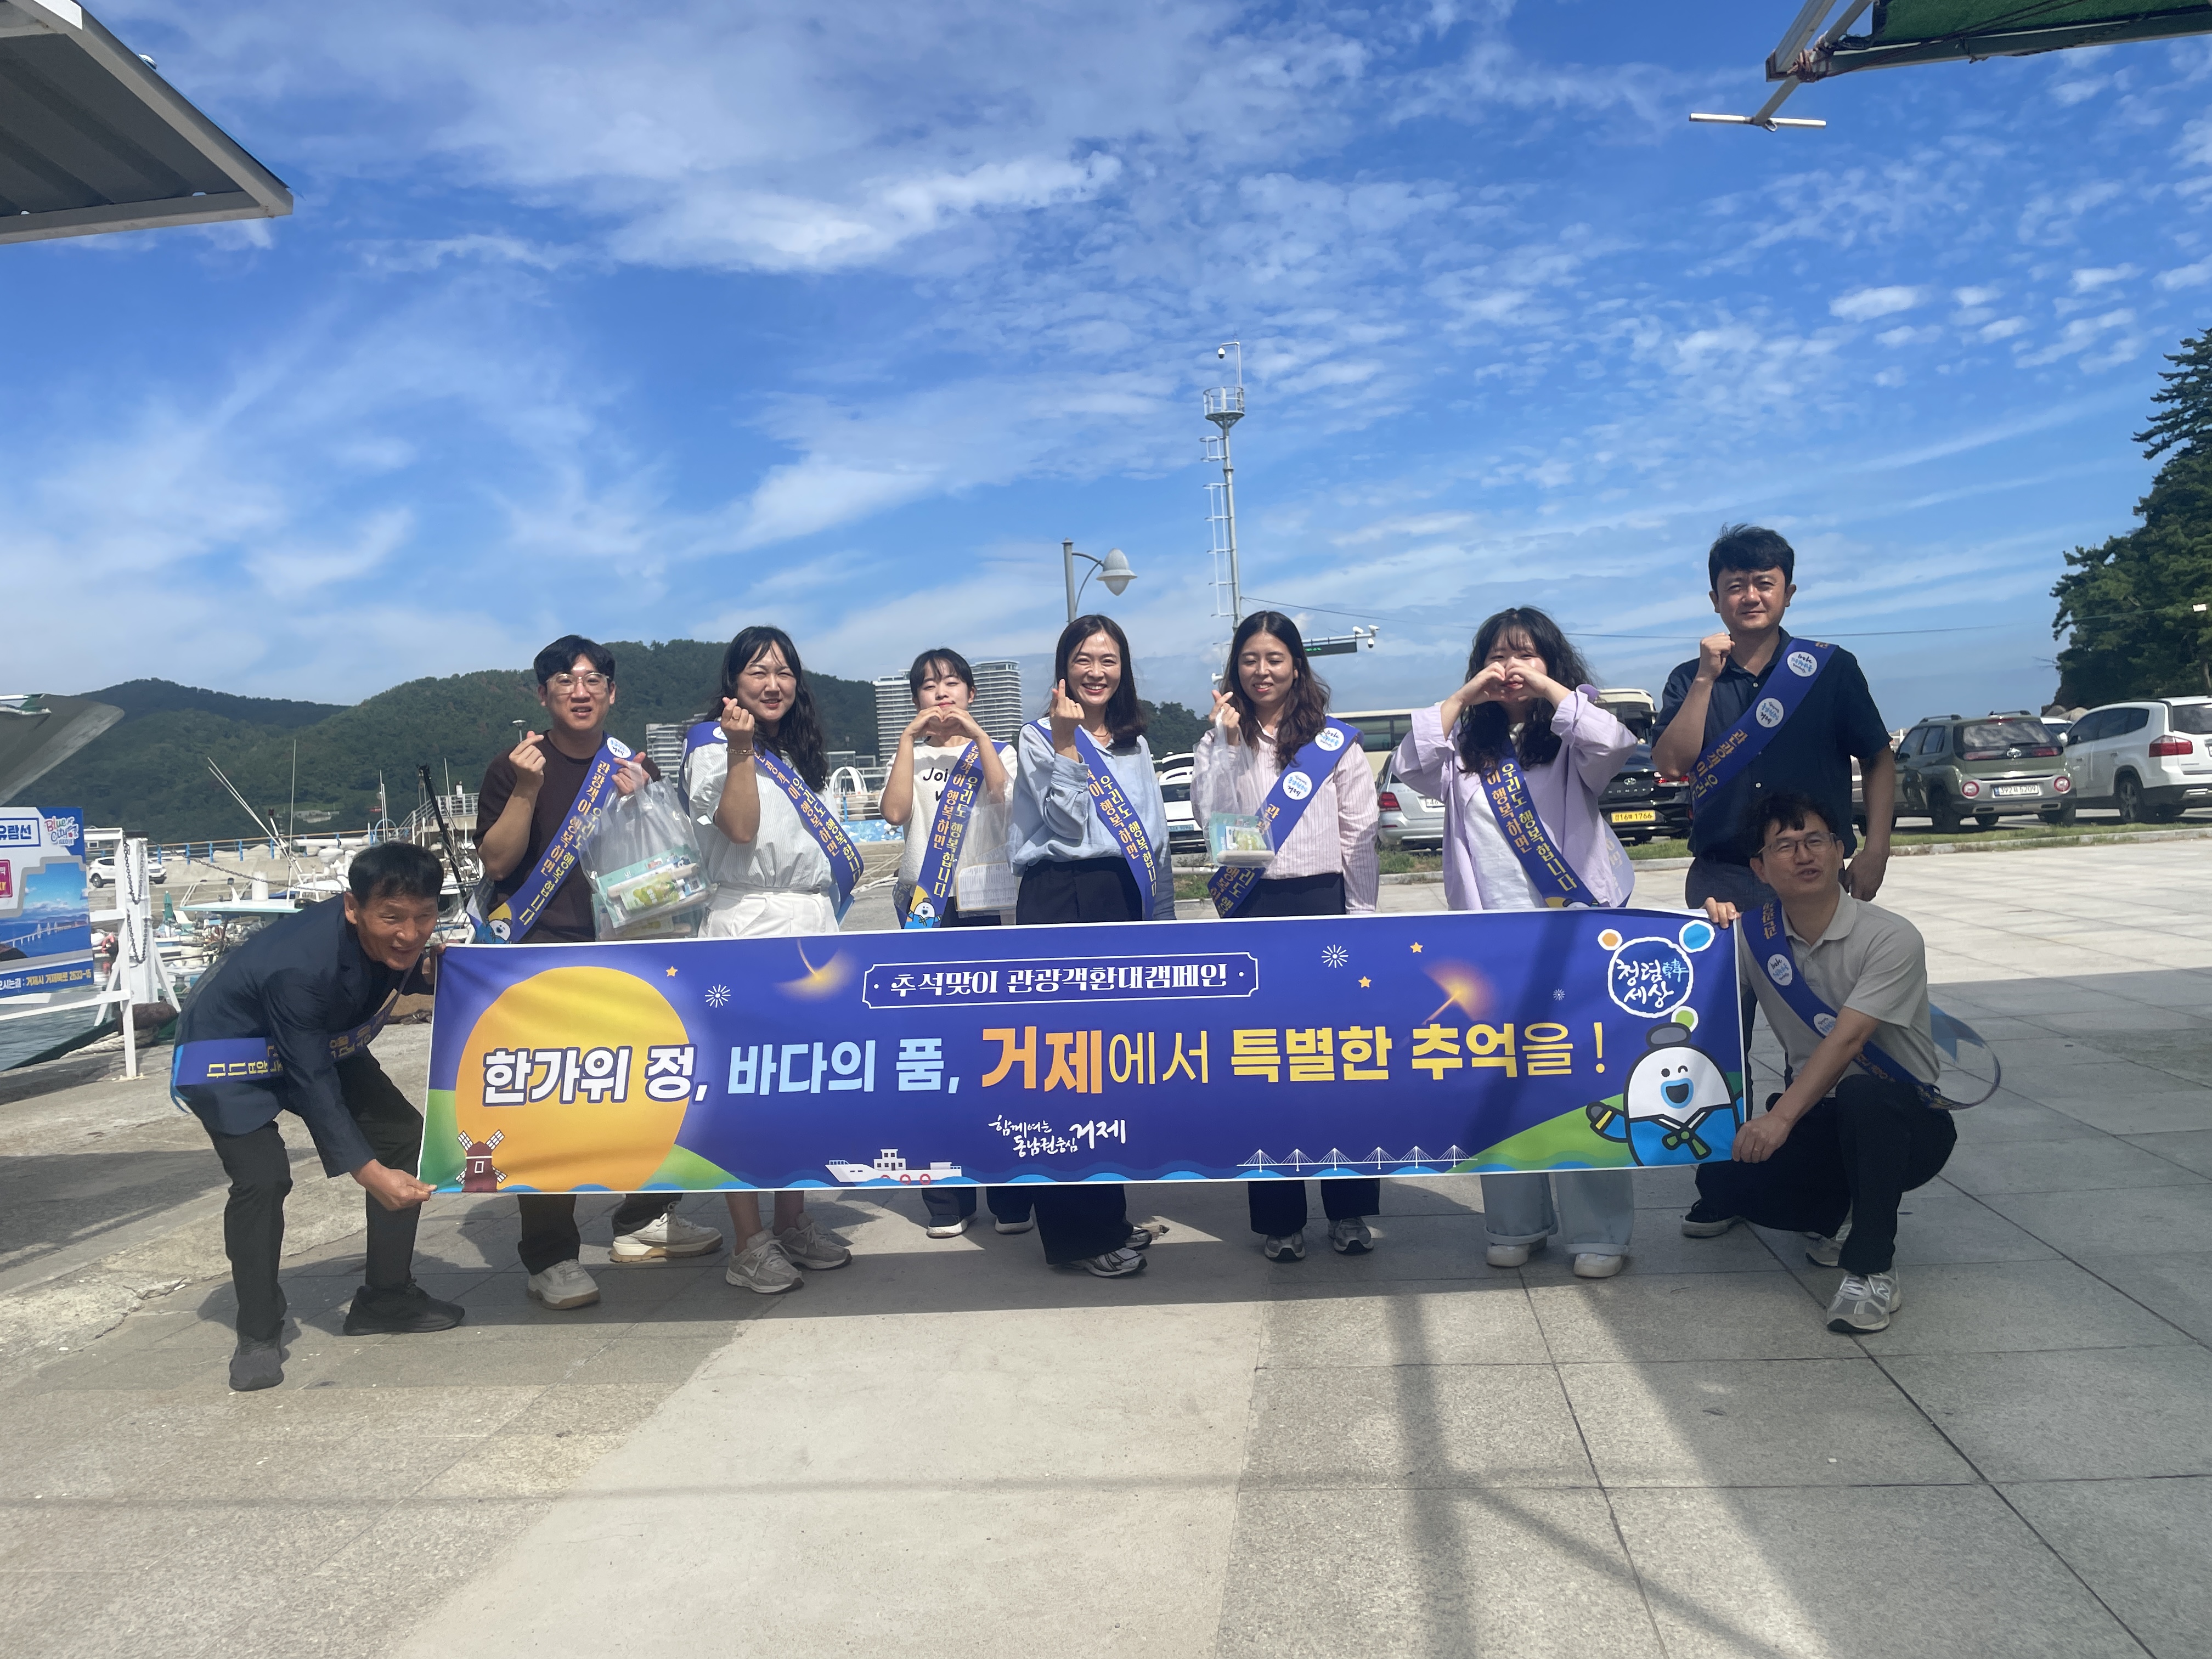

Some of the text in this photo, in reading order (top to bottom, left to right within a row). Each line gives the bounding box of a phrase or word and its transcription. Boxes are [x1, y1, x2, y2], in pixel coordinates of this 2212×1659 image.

[1696, 729, 1748, 777] 관광객이
[541, 760, 611, 877] 관광객이 행복하면
[792, 777, 826, 818] 우리도
[933, 789, 960, 850] 행복하면
[1100, 775, 1133, 820] 우리도
[1492, 787, 1532, 854] 행복하면
[44, 817, 66, 832] Blue
[800, 800, 840, 857] 행복하면
[933, 776, 978, 898] 우리도 행복합니다
[1099, 799, 1140, 860] 행복하면
[1502, 763, 1577, 891] 우리도 행복합니다
[518, 851, 575, 926] 행복합니다
[1211, 867, 1240, 904] 행복하
[1229, 867, 1255, 898] 리도
[26, 975, 44, 986] 거제시
[890, 963, 1227, 996] 추석맞이 관광객환대캠페인
[1623, 980, 1674, 1008] 세상
[483, 1022, 1606, 1106] 한가위 정, 바다의 품, 거제에서 특별한 추억을 !
[1069, 1120, 1126, 1149] 거제
